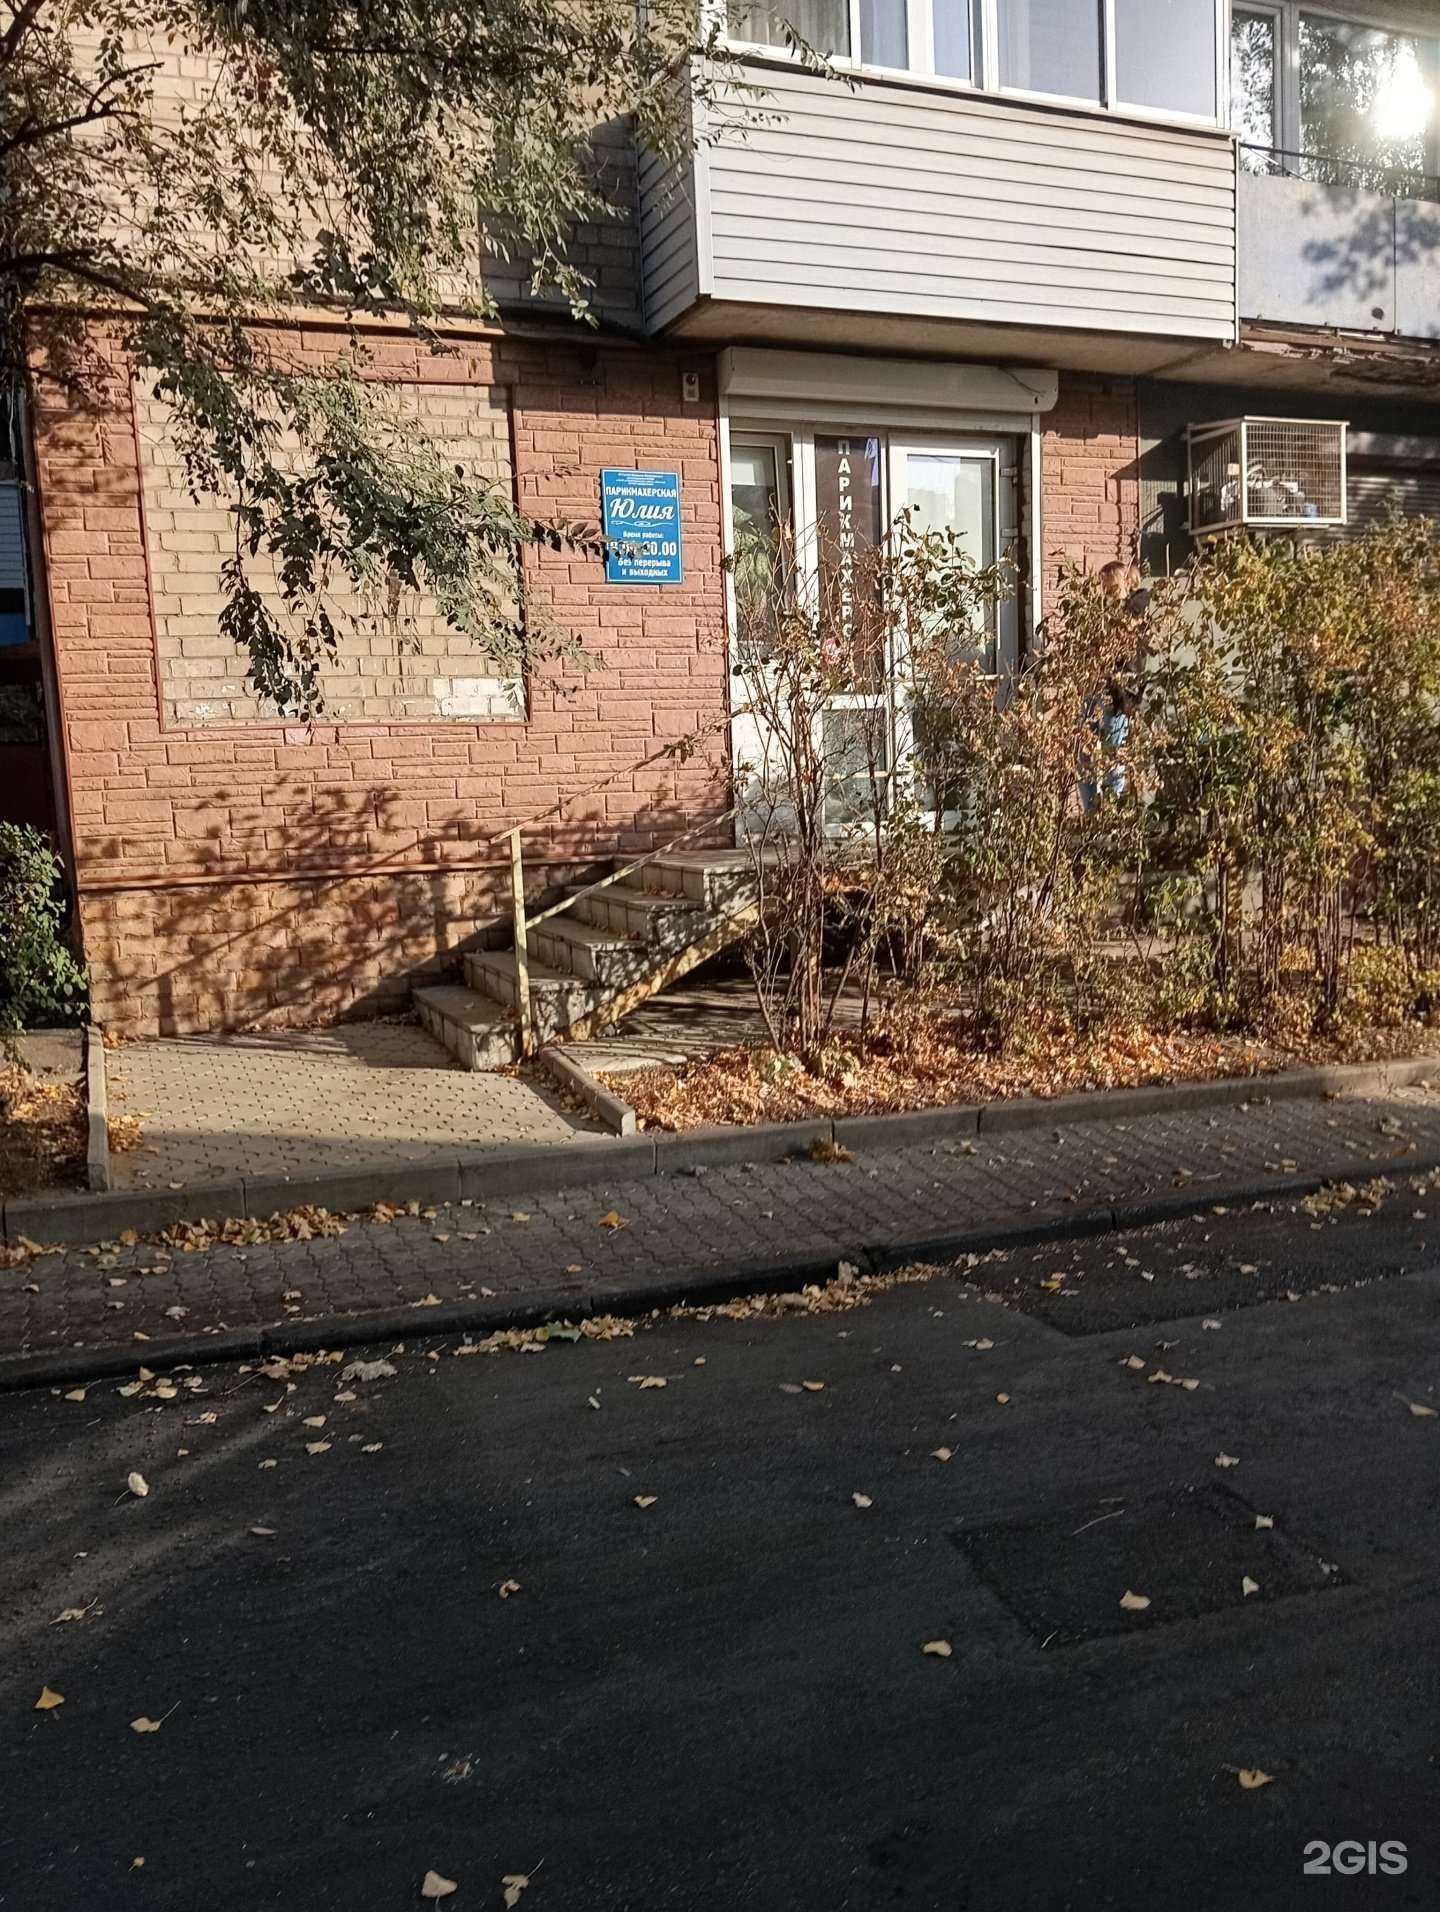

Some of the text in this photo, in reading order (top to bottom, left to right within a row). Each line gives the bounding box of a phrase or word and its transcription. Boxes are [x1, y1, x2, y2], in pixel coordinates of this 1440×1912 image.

[605, 486, 677, 498] ПАРИКМАХЕРСКАЯ
[609, 498, 675, 520] Юлия
[634, 559, 672, 568] перерыва
[838, 440, 855, 692] ПАРИКМАХЕРС
[629, 568, 669, 578] выходных
